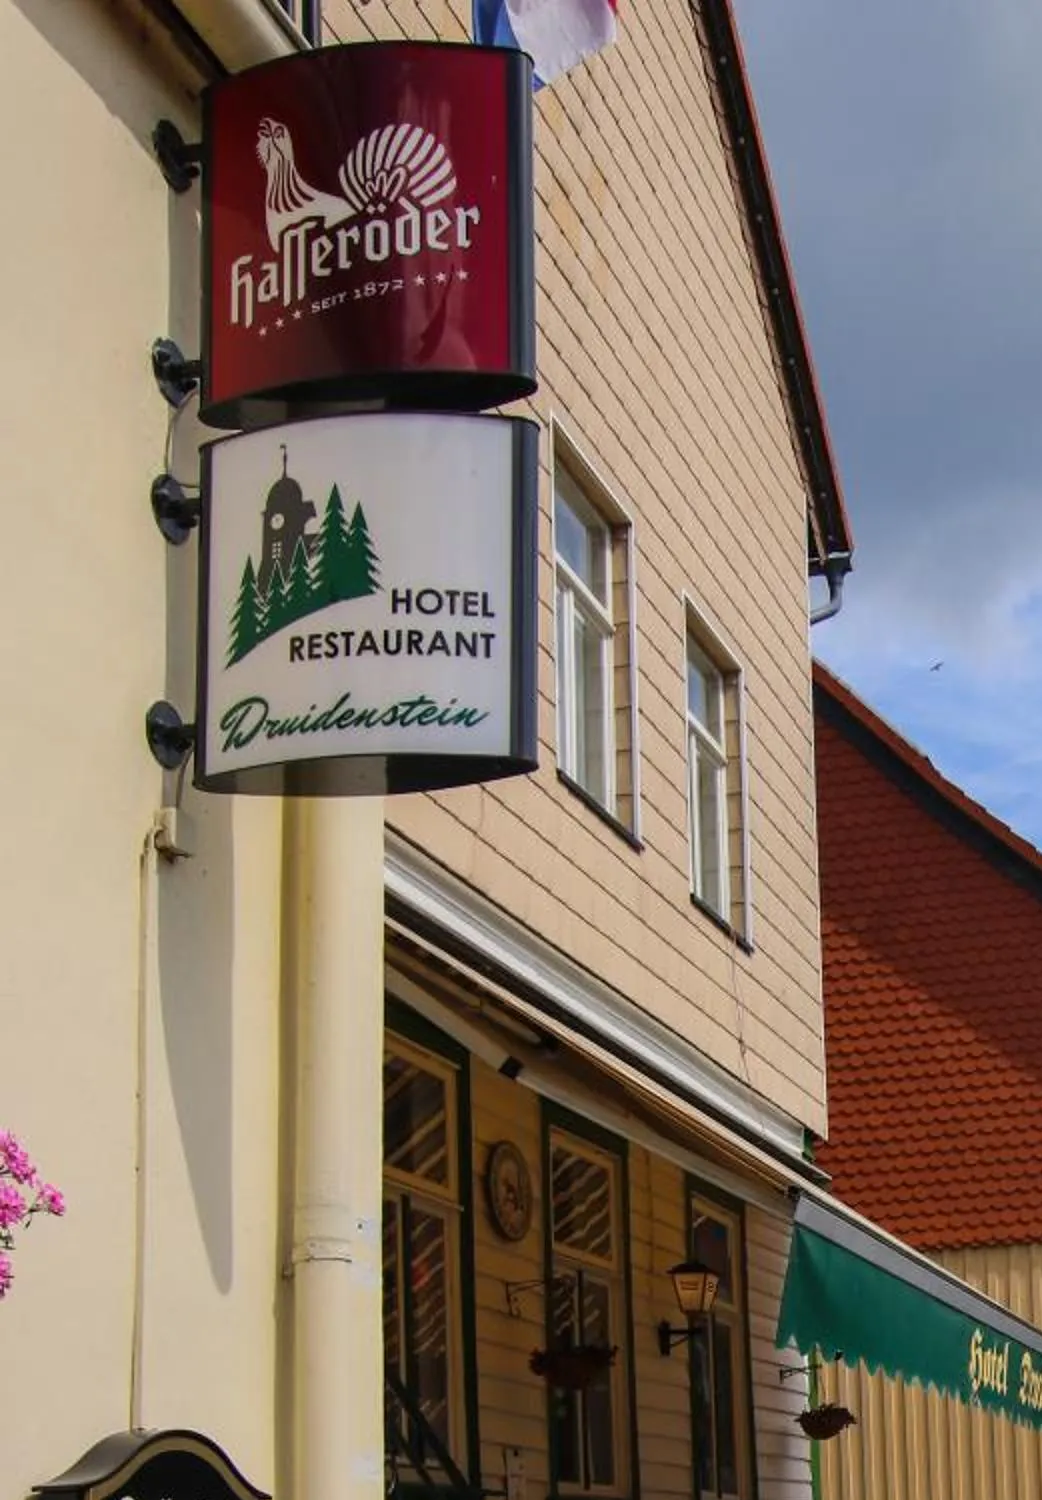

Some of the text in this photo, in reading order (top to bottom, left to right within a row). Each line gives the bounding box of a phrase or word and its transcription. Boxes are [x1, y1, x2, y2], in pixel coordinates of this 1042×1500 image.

[311, 278, 404, 314] SEIT 1872
[391, 588, 495, 618] HOTEL
[289, 629, 496, 662] RESTAURANT
[220, 692, 490, 752] Druidenstein
